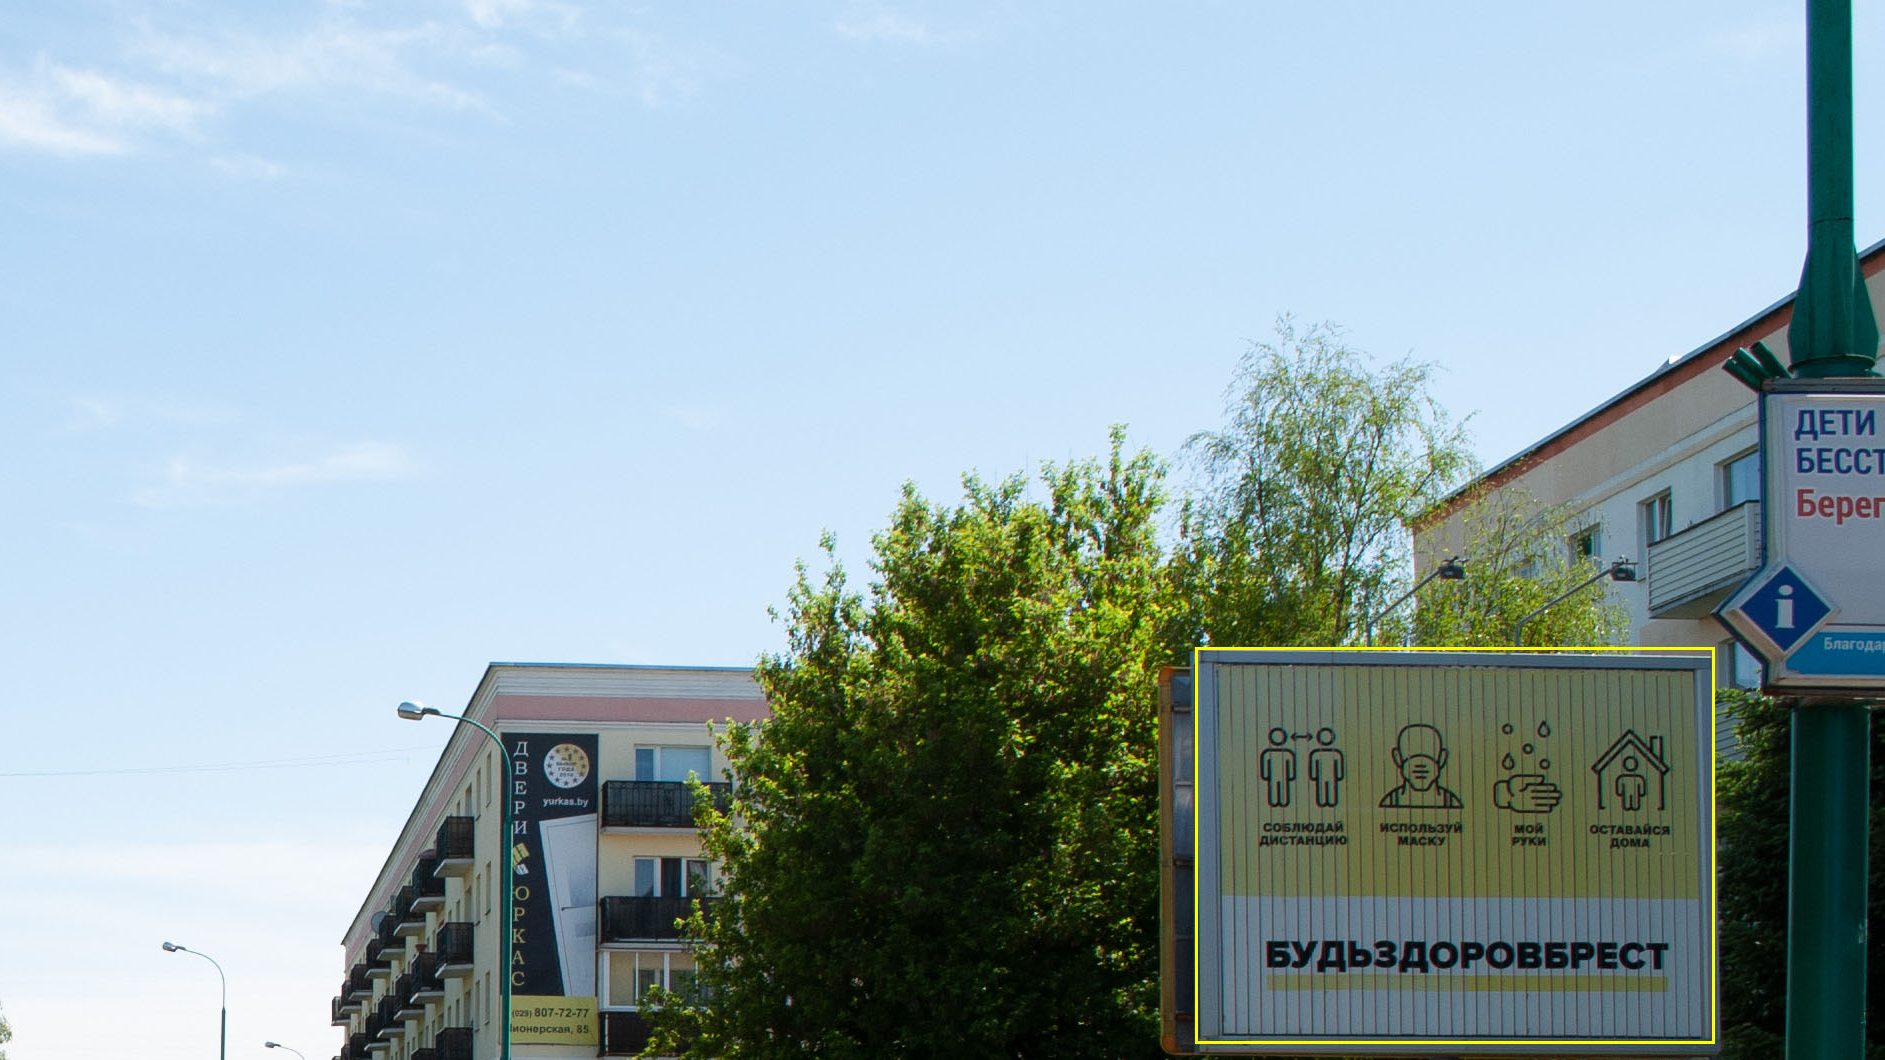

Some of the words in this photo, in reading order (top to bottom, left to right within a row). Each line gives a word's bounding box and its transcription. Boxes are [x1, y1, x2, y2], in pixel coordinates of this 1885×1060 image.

[1795, 409, 1875, 441] ДЕТИ
[513, 740, 529, 835] ДВЕРИ
[543, 796, 589, 808] yurkas.by
[1263, 821, 1344, 833] СОБЛЮДАЙ
[1379, 821, 1464, 834] ИСПОЛЬЗУЙ
[1514, 822, 1544, 834] МОЙ
[1589, 824, 1670, 836] ОСТАВАЙСЯ
[1259, 835, 1348, 847] ДИСТАНЦИЮ
[1397, 836, 1446, 846] МАСКУ
[1511, 836, 1546, 846] РУКИ
[1609, 837, 1651, 849] ДОМА
[1265, 939, 1670, 973] БУДЬЗДОРОВБРЕСТ
[534, 1008, 589, 1018] 807-72-77
[576, 1025, 589, 1034] 85
